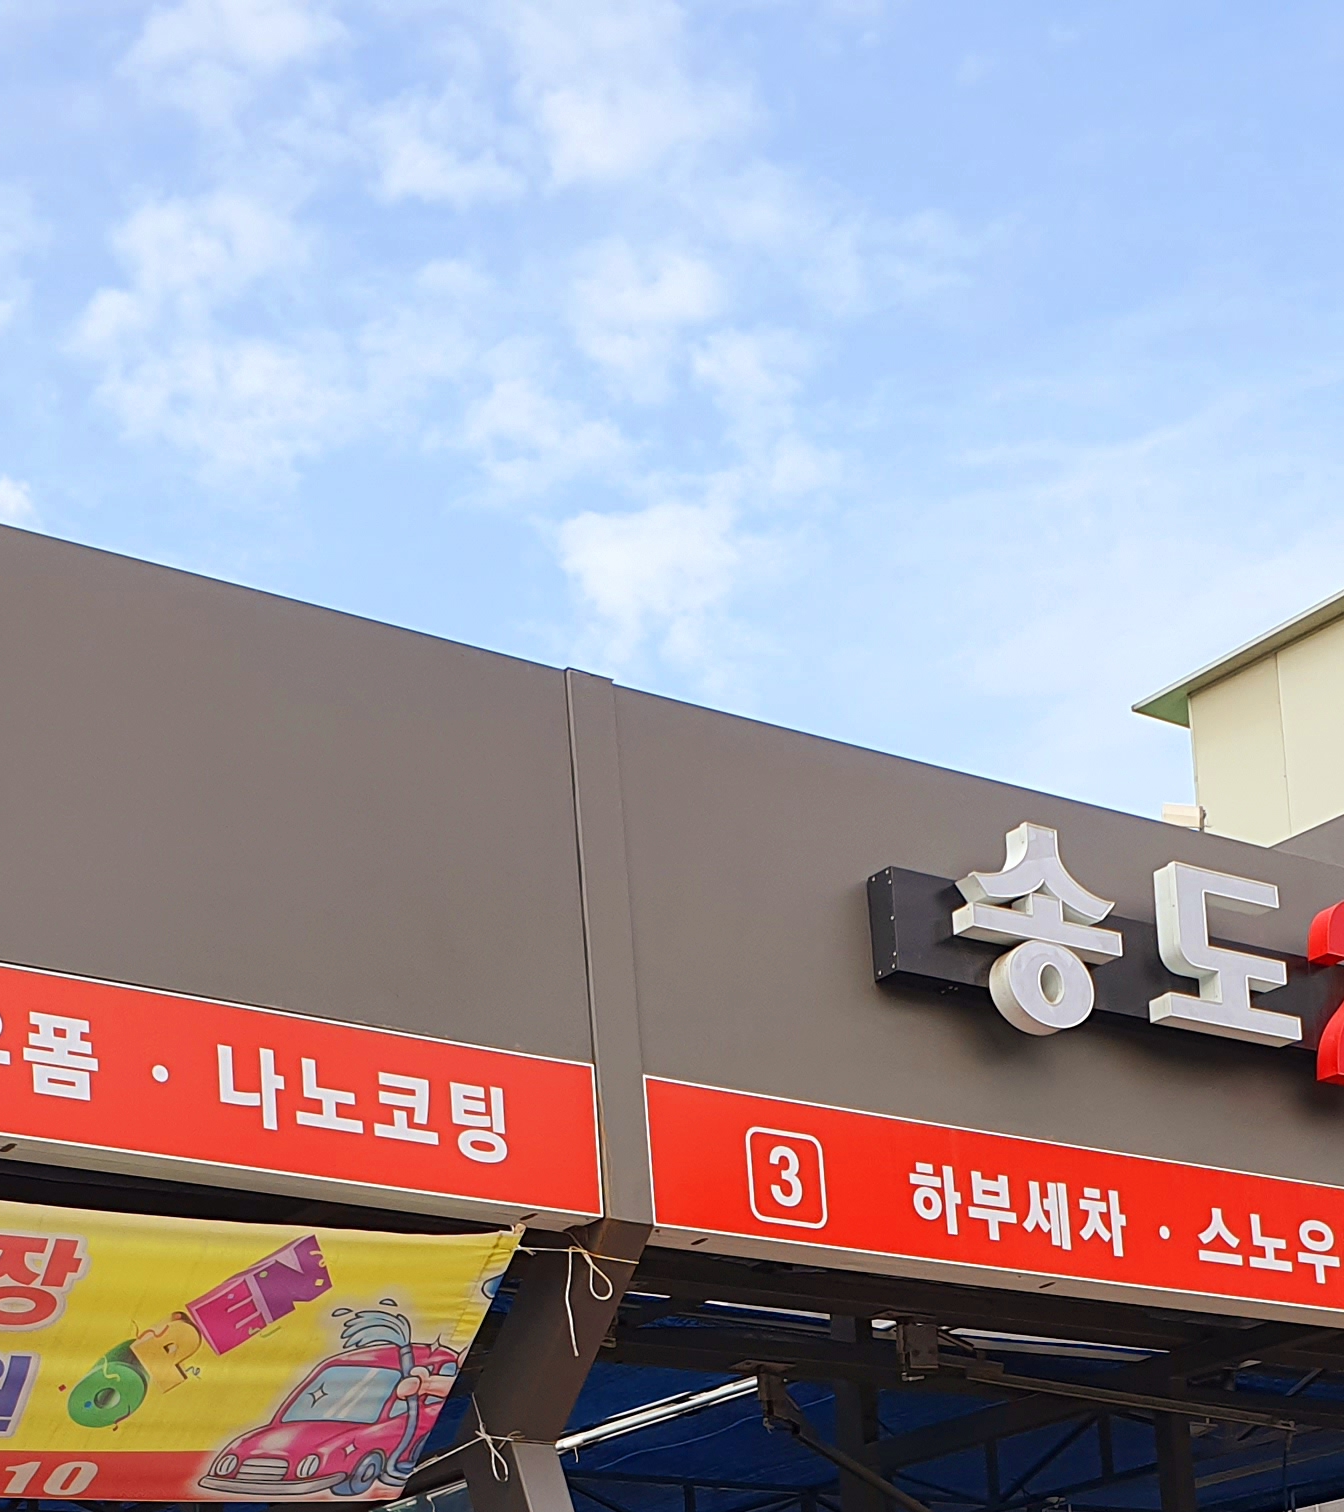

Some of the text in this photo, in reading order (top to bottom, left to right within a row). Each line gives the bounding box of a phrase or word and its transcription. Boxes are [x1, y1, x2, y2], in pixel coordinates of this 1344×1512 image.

[217, 1045, 510, 1164] 나노코팅
[770, 1146, 802, 1206] 3
[909, 1162, 1128, 1258] 하부세차
[67, 1234, 333, 1428] OPEN
